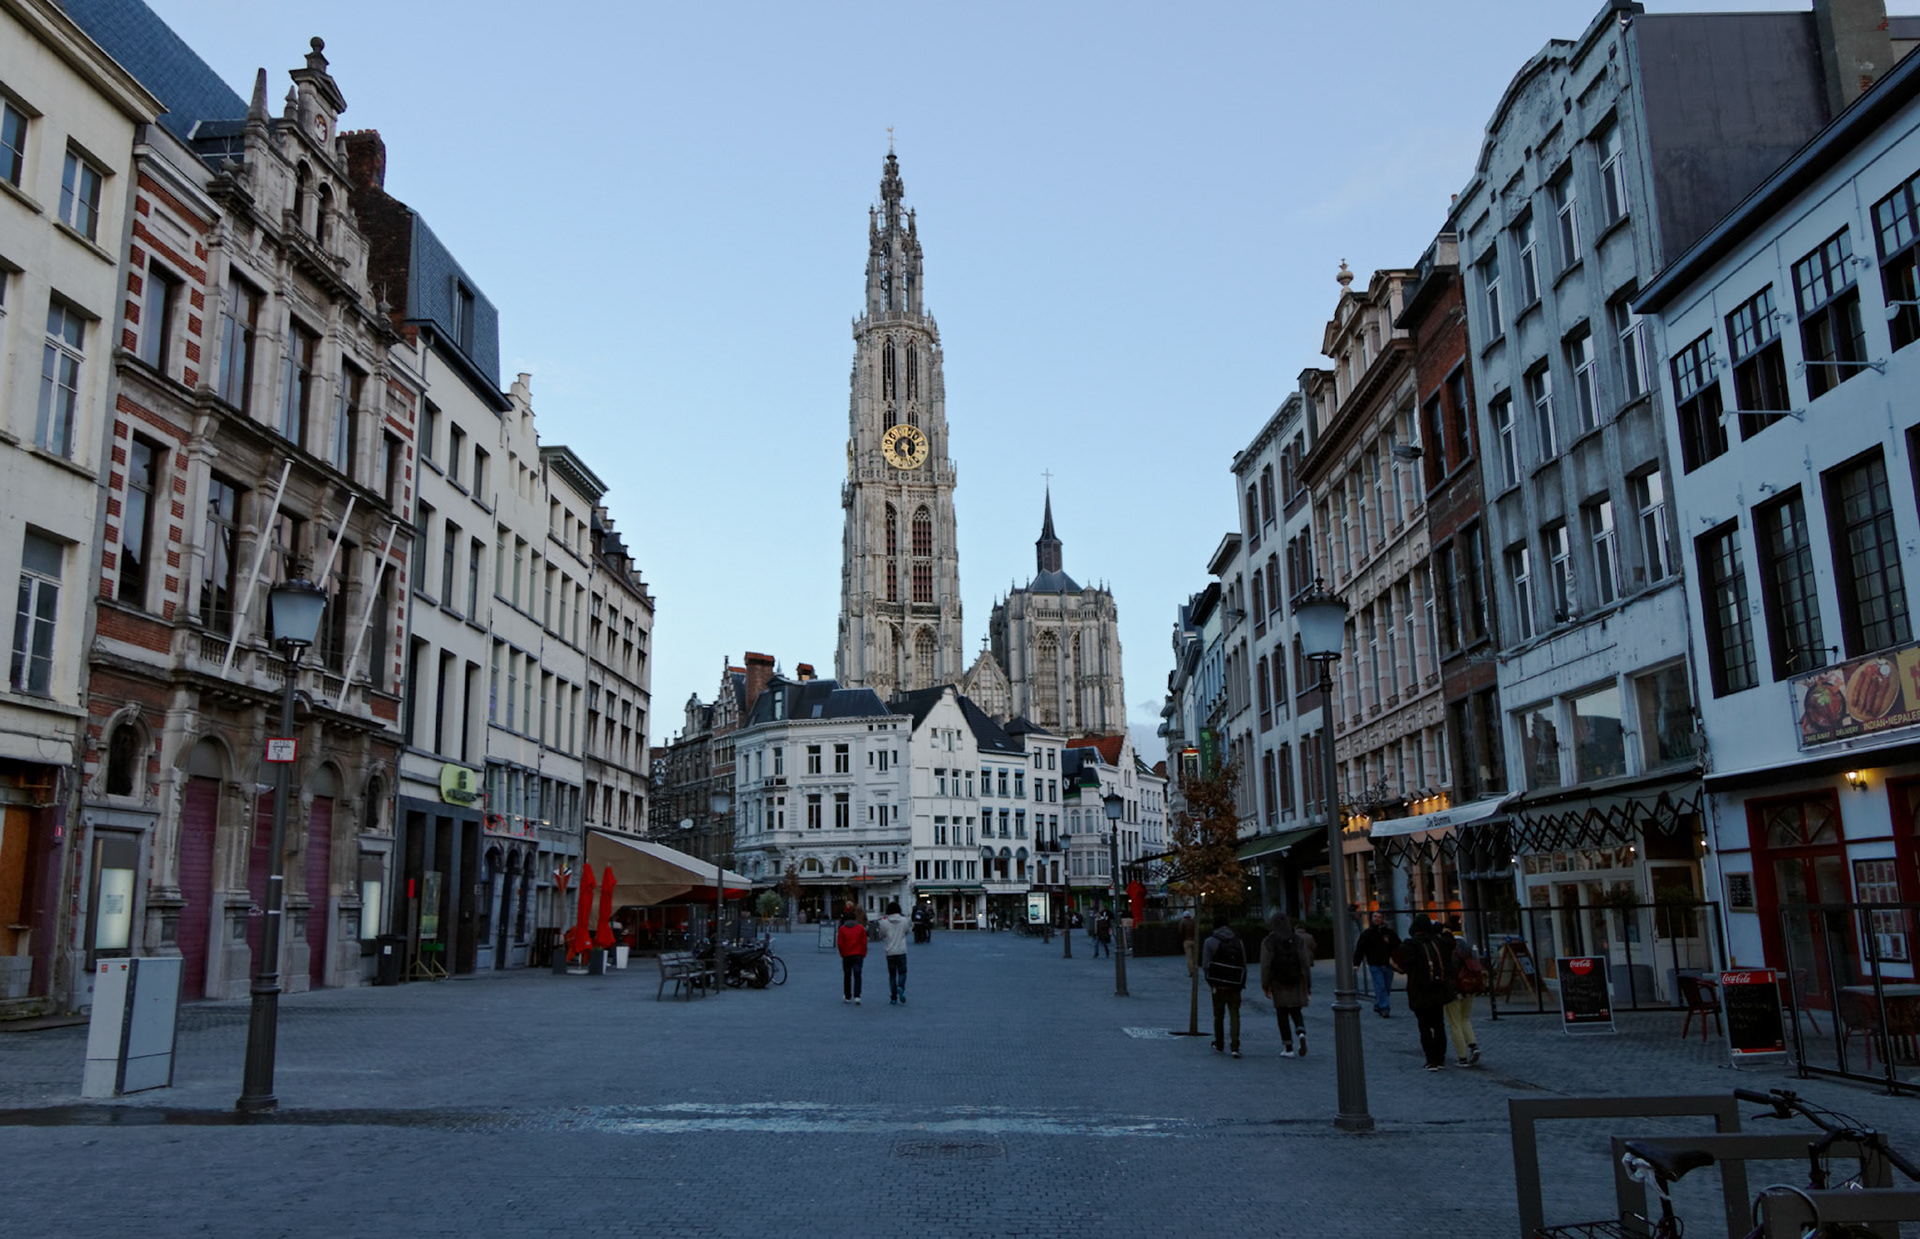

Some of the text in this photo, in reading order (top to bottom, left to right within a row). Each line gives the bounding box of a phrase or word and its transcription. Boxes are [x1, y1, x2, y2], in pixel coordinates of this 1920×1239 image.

[1835, 725, 1859, 737] DELIVERY
[1426, 818, 1434, 828] De
[1570, 959, 1590, 968] Coca-Cola
[1722, 972, 1751, 984] Coca-Cola
